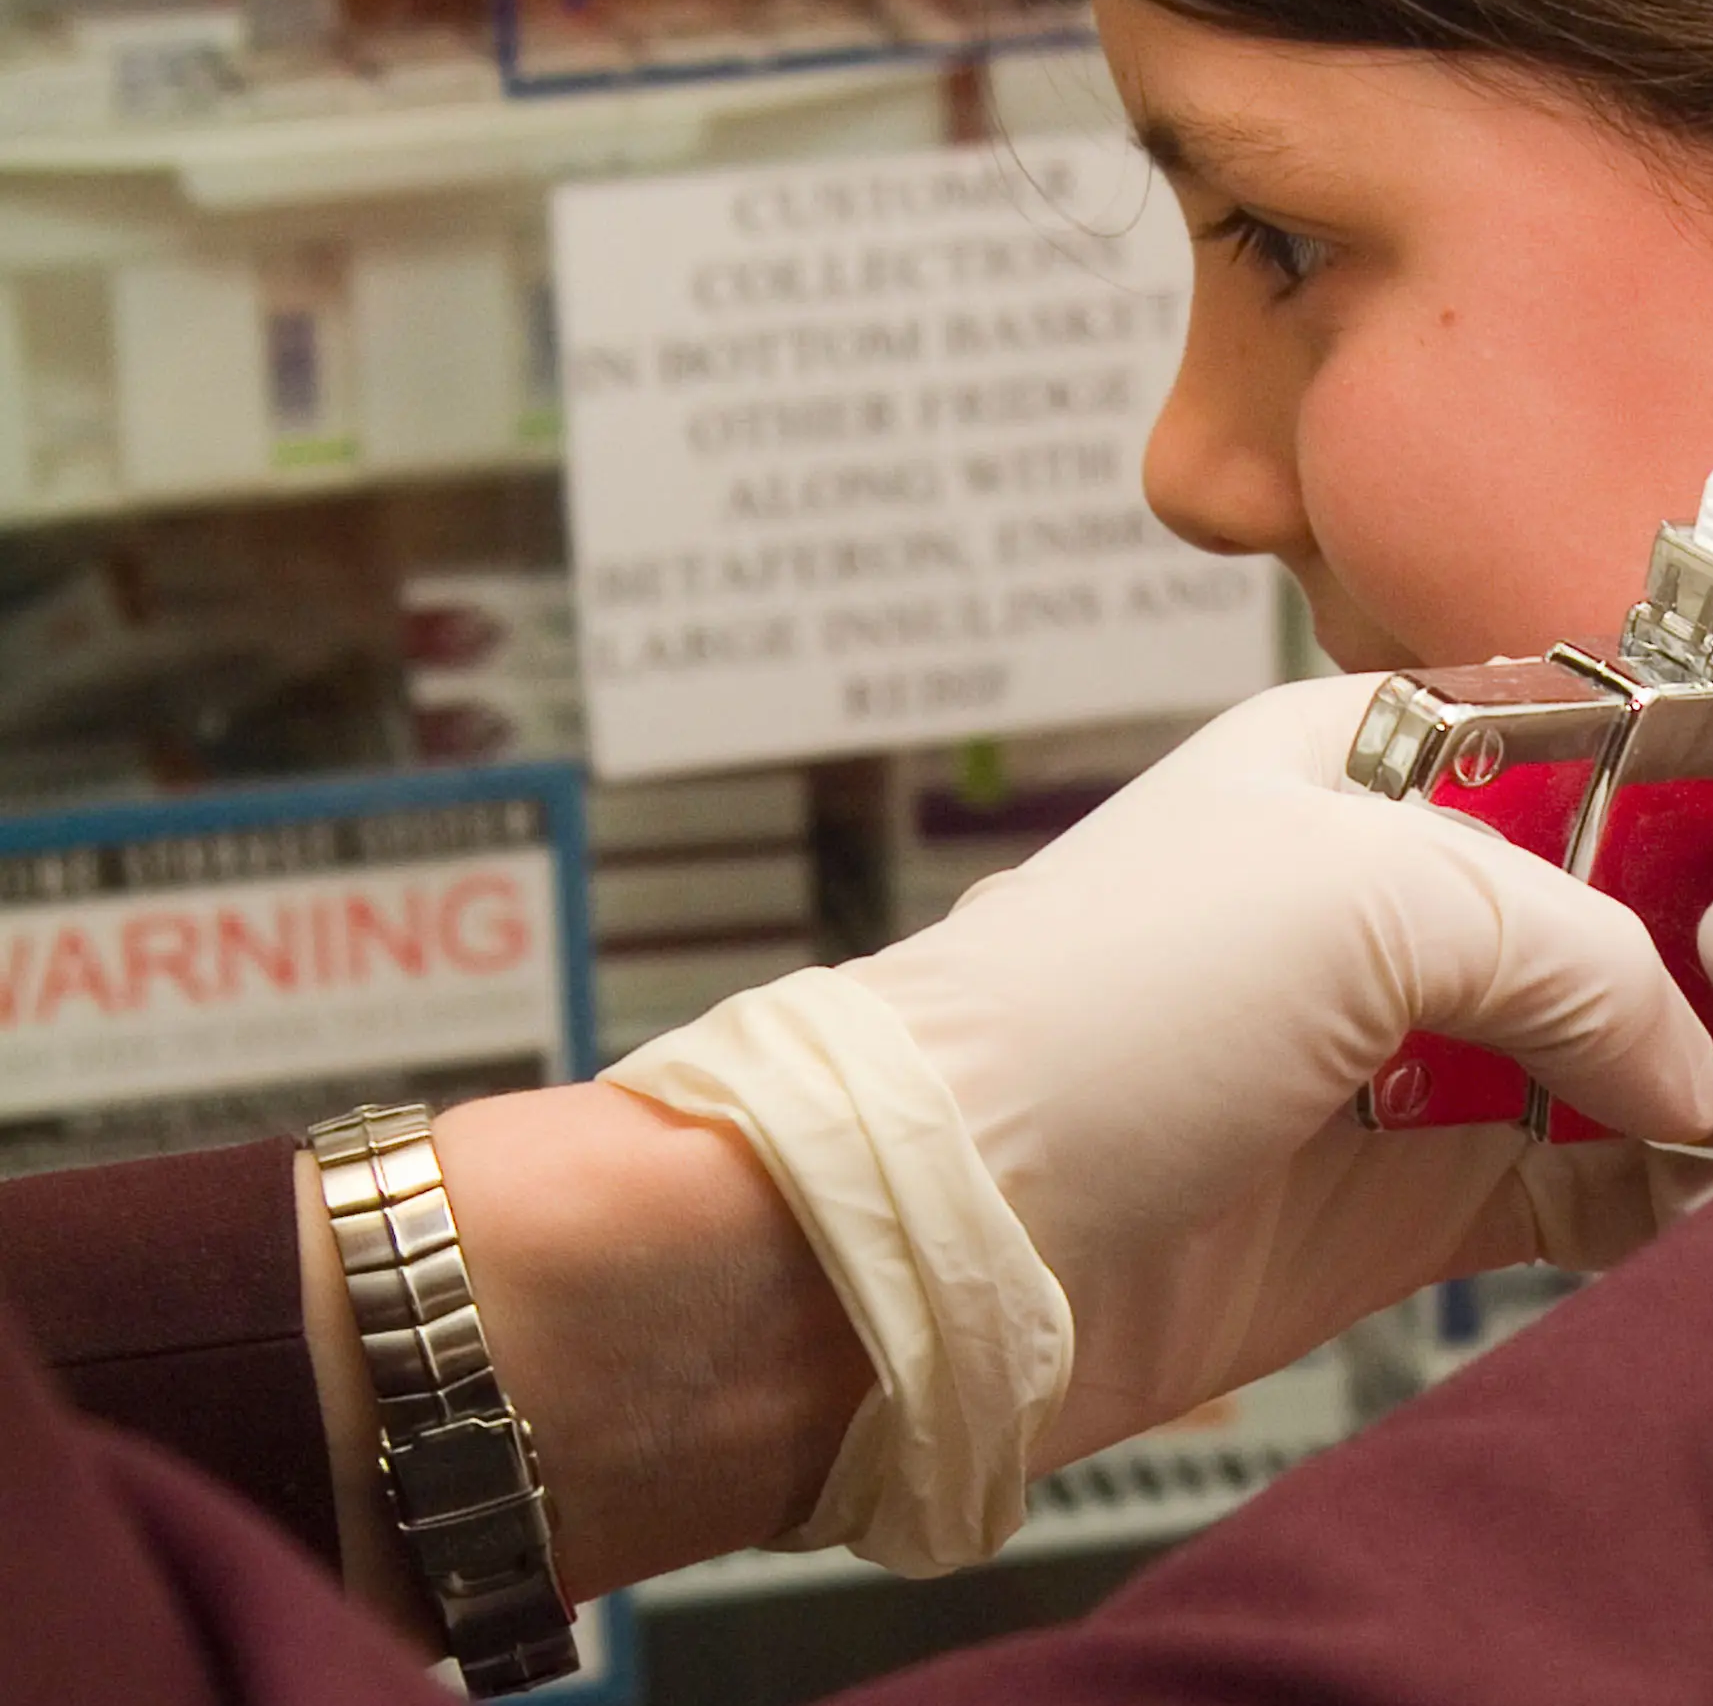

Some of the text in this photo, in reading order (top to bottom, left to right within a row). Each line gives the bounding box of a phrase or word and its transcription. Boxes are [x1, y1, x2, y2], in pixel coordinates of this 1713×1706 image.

[727, 159, 1077, 236] CUSTOMER
[656, 322, 921, 386] BOTTOM
[943, 291, 1180, 364] BASKET
[686, 365, 1134, 454] OTHER FRIDGE
[723, 439, 1122, 523] ALONG WITH
[592, 564, 1251, 677] LARGE INSULINS AND
